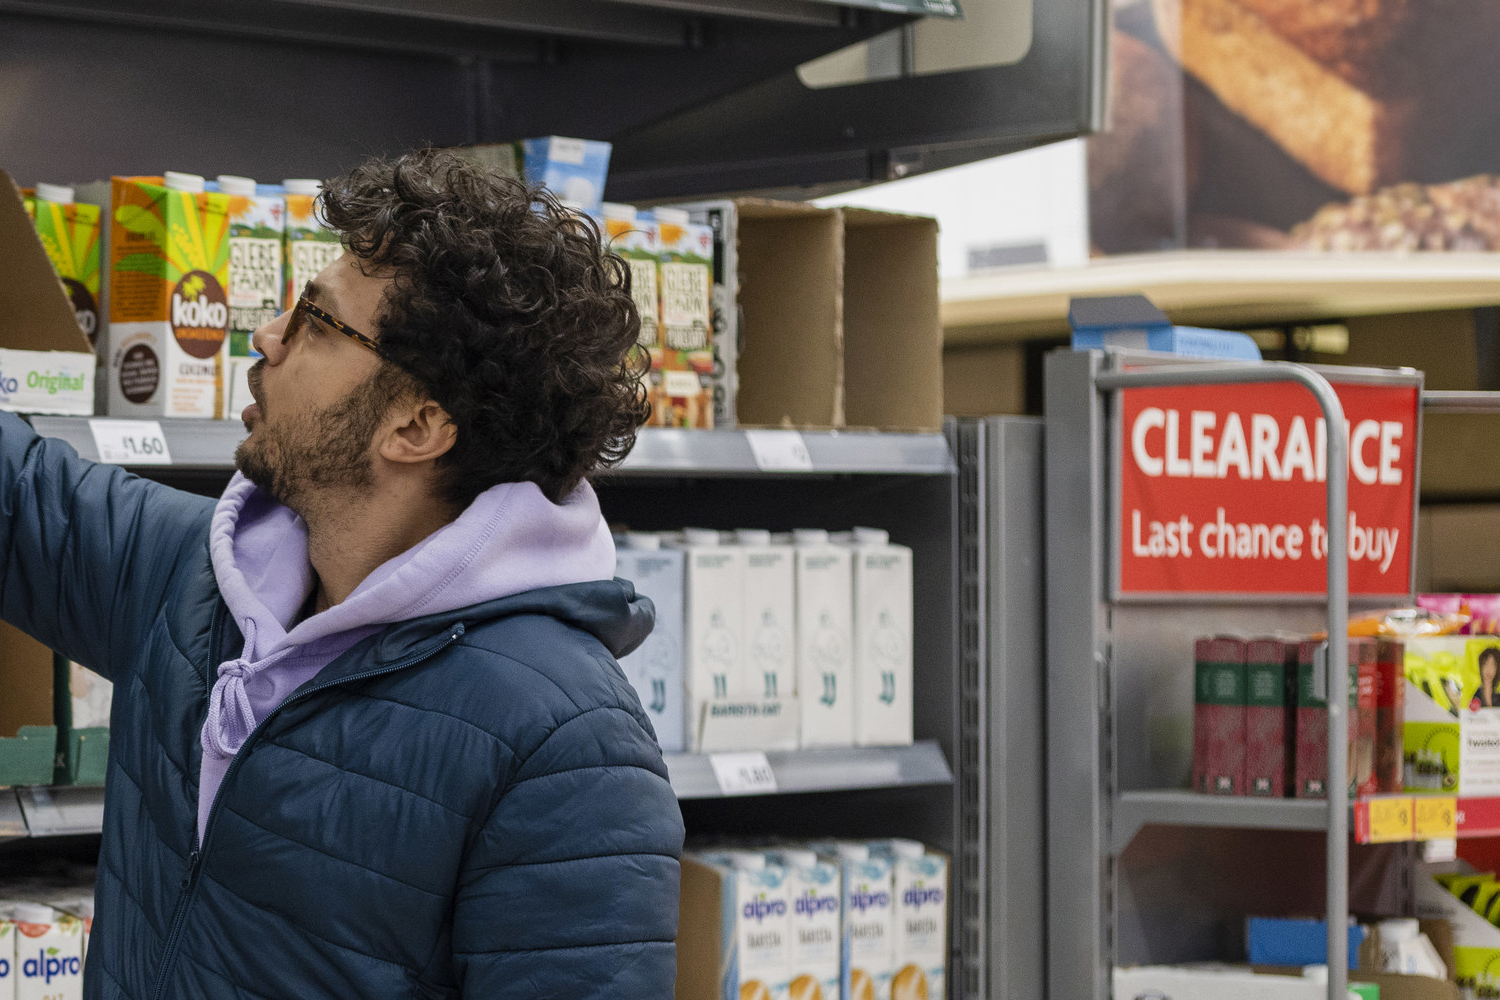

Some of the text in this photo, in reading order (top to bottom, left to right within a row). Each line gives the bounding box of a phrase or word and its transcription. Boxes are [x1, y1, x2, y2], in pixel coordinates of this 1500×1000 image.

[172, 293, 228, 329] koko
[26, 370, 85, 395] Original
[122, 436, 164, 456] £1.60
[1132, 508, 1195, 559] Last
[1199, 506, 1304, 560] chance
[1347, 510, 1400, 575] buy
[743, 893, 787, 924] alpro
